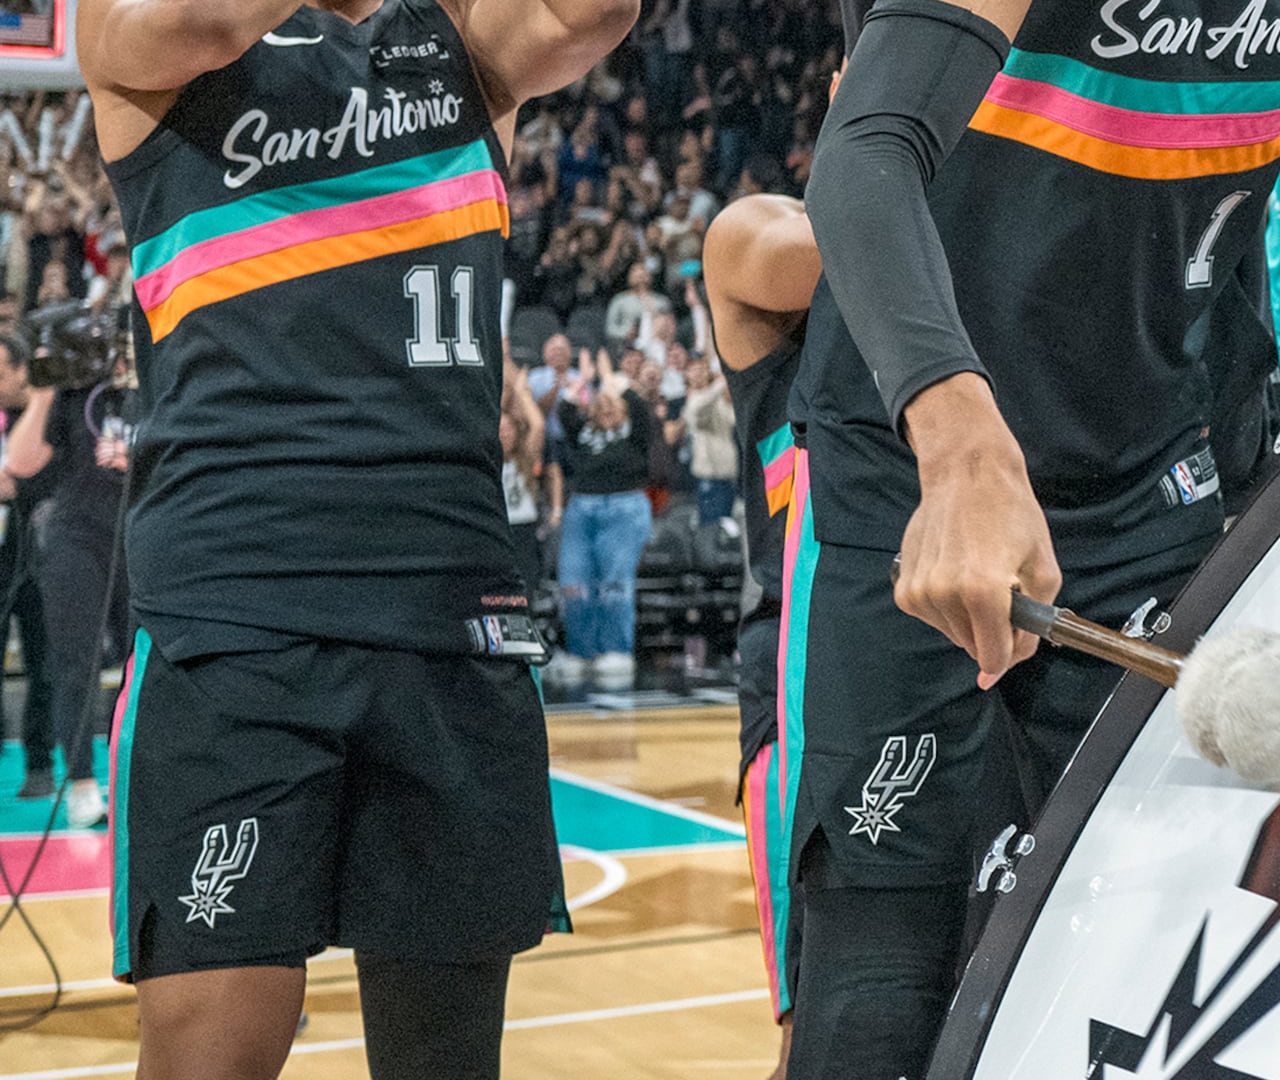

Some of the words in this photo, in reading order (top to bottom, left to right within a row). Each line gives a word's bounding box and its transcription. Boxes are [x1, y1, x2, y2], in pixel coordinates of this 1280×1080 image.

[381, 41, 439, 60] LEDGER
[222, 108, 318, 189] San
[322, 80, 464, 159] Antonio
[1185, 190, 1252, 290] 1
[403, 265, 485, 367] 11
